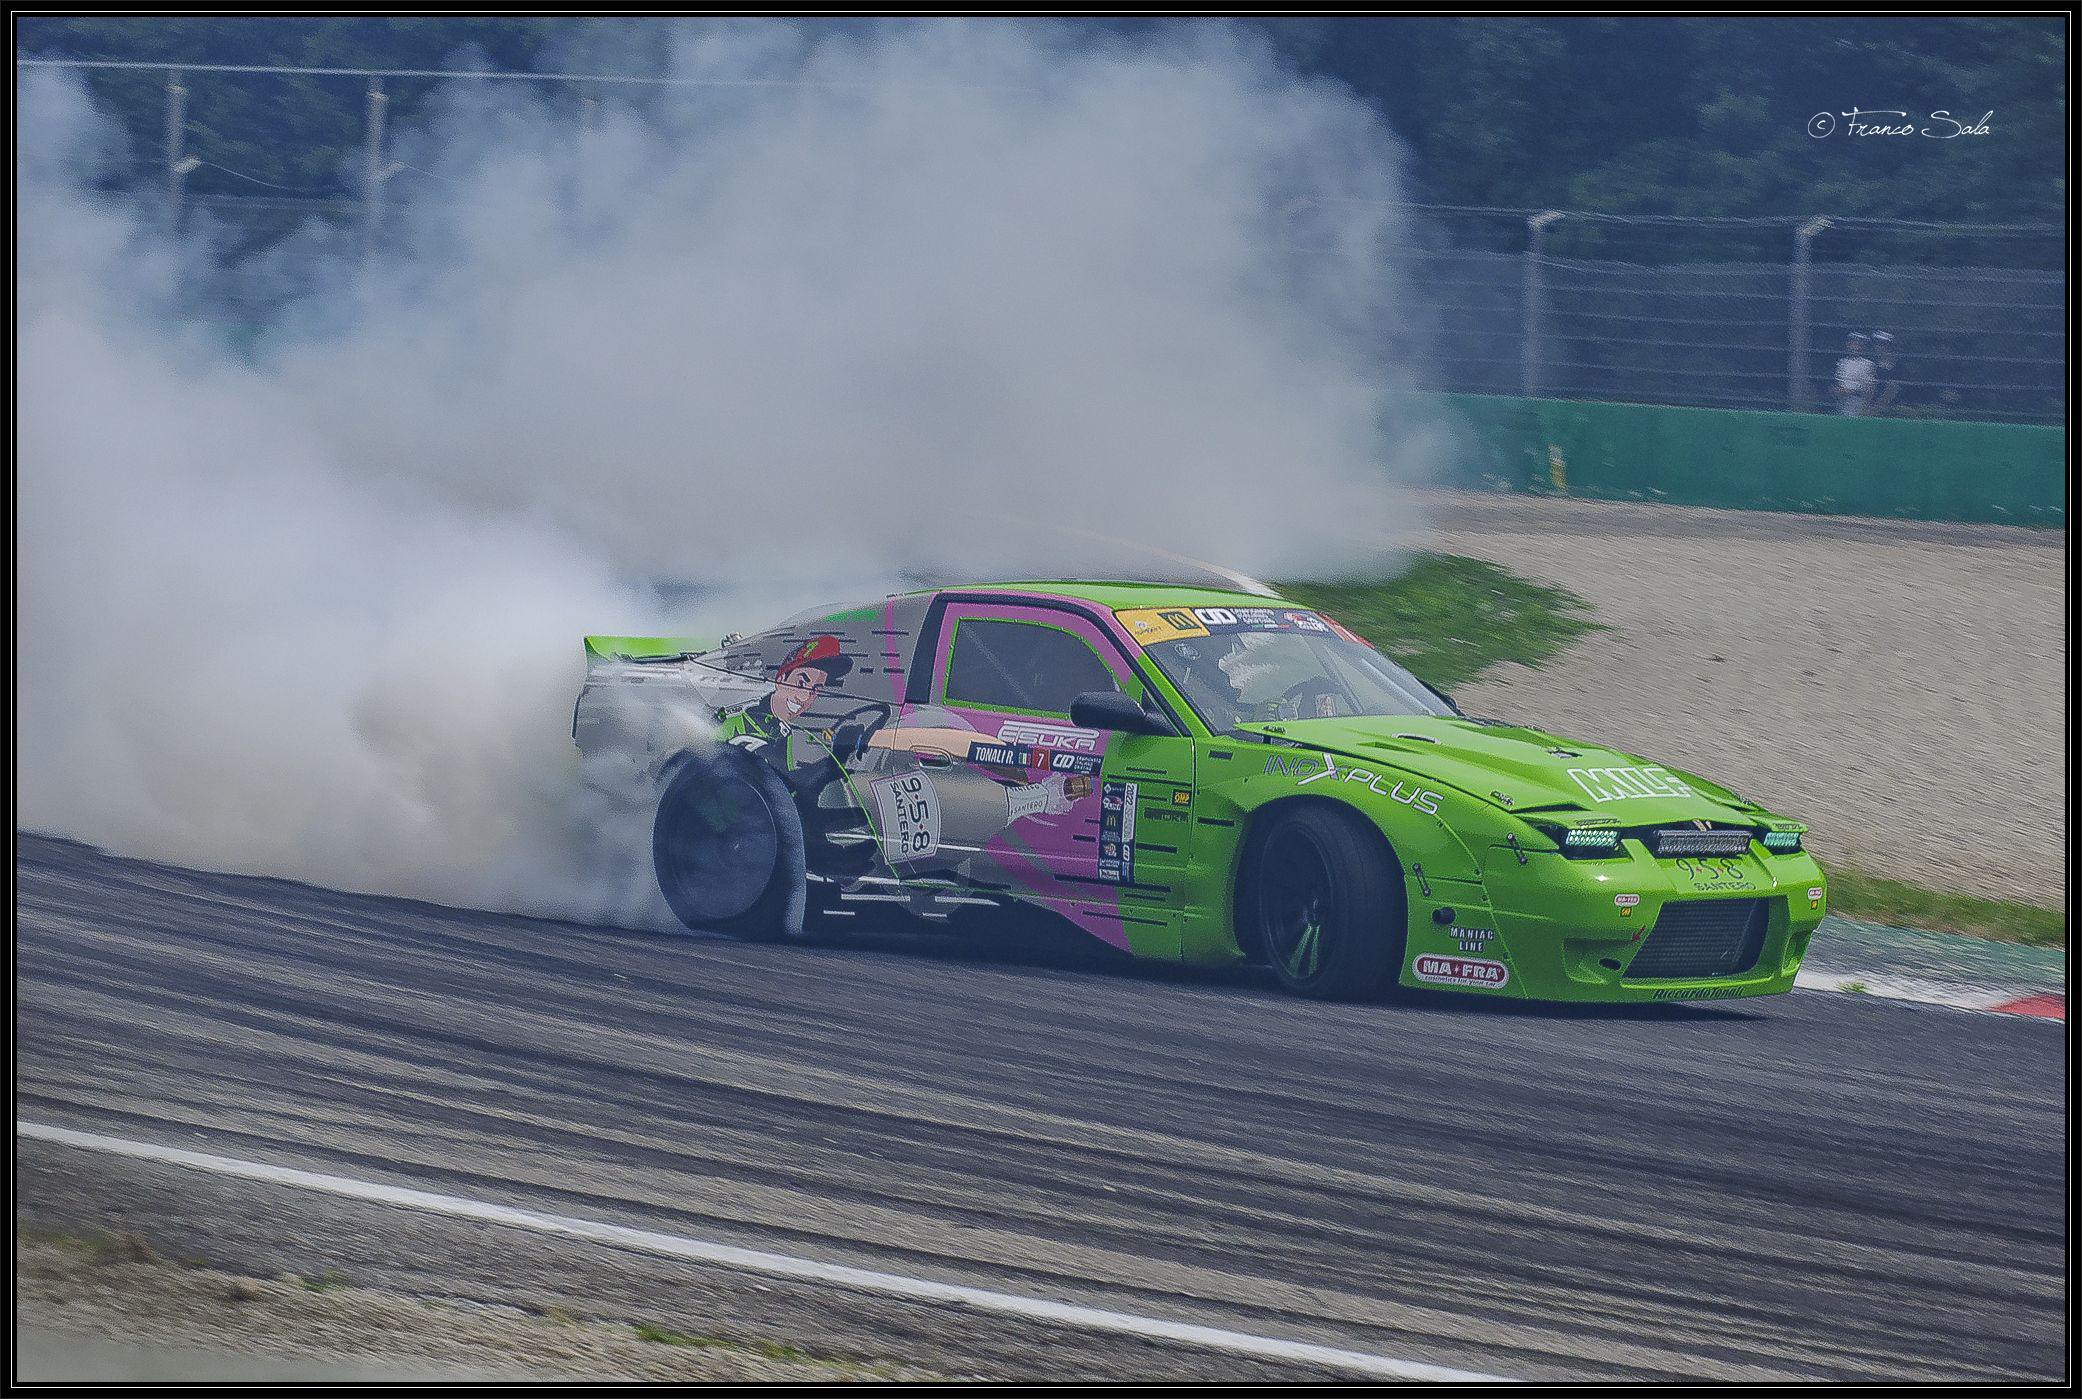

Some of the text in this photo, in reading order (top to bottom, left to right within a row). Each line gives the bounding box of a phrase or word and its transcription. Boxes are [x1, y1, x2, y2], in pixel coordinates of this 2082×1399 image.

[975, 746, 1015, 765] TONALI R.
[1036, 752, 1046, 768] 7
[889, 782, 910, 854] SANTERO
[1692, 881, 1757, 892] SANTERO
[1450, 926, 1495, 940] MANIAC
[1459, 940, 1484, 952] LINE
